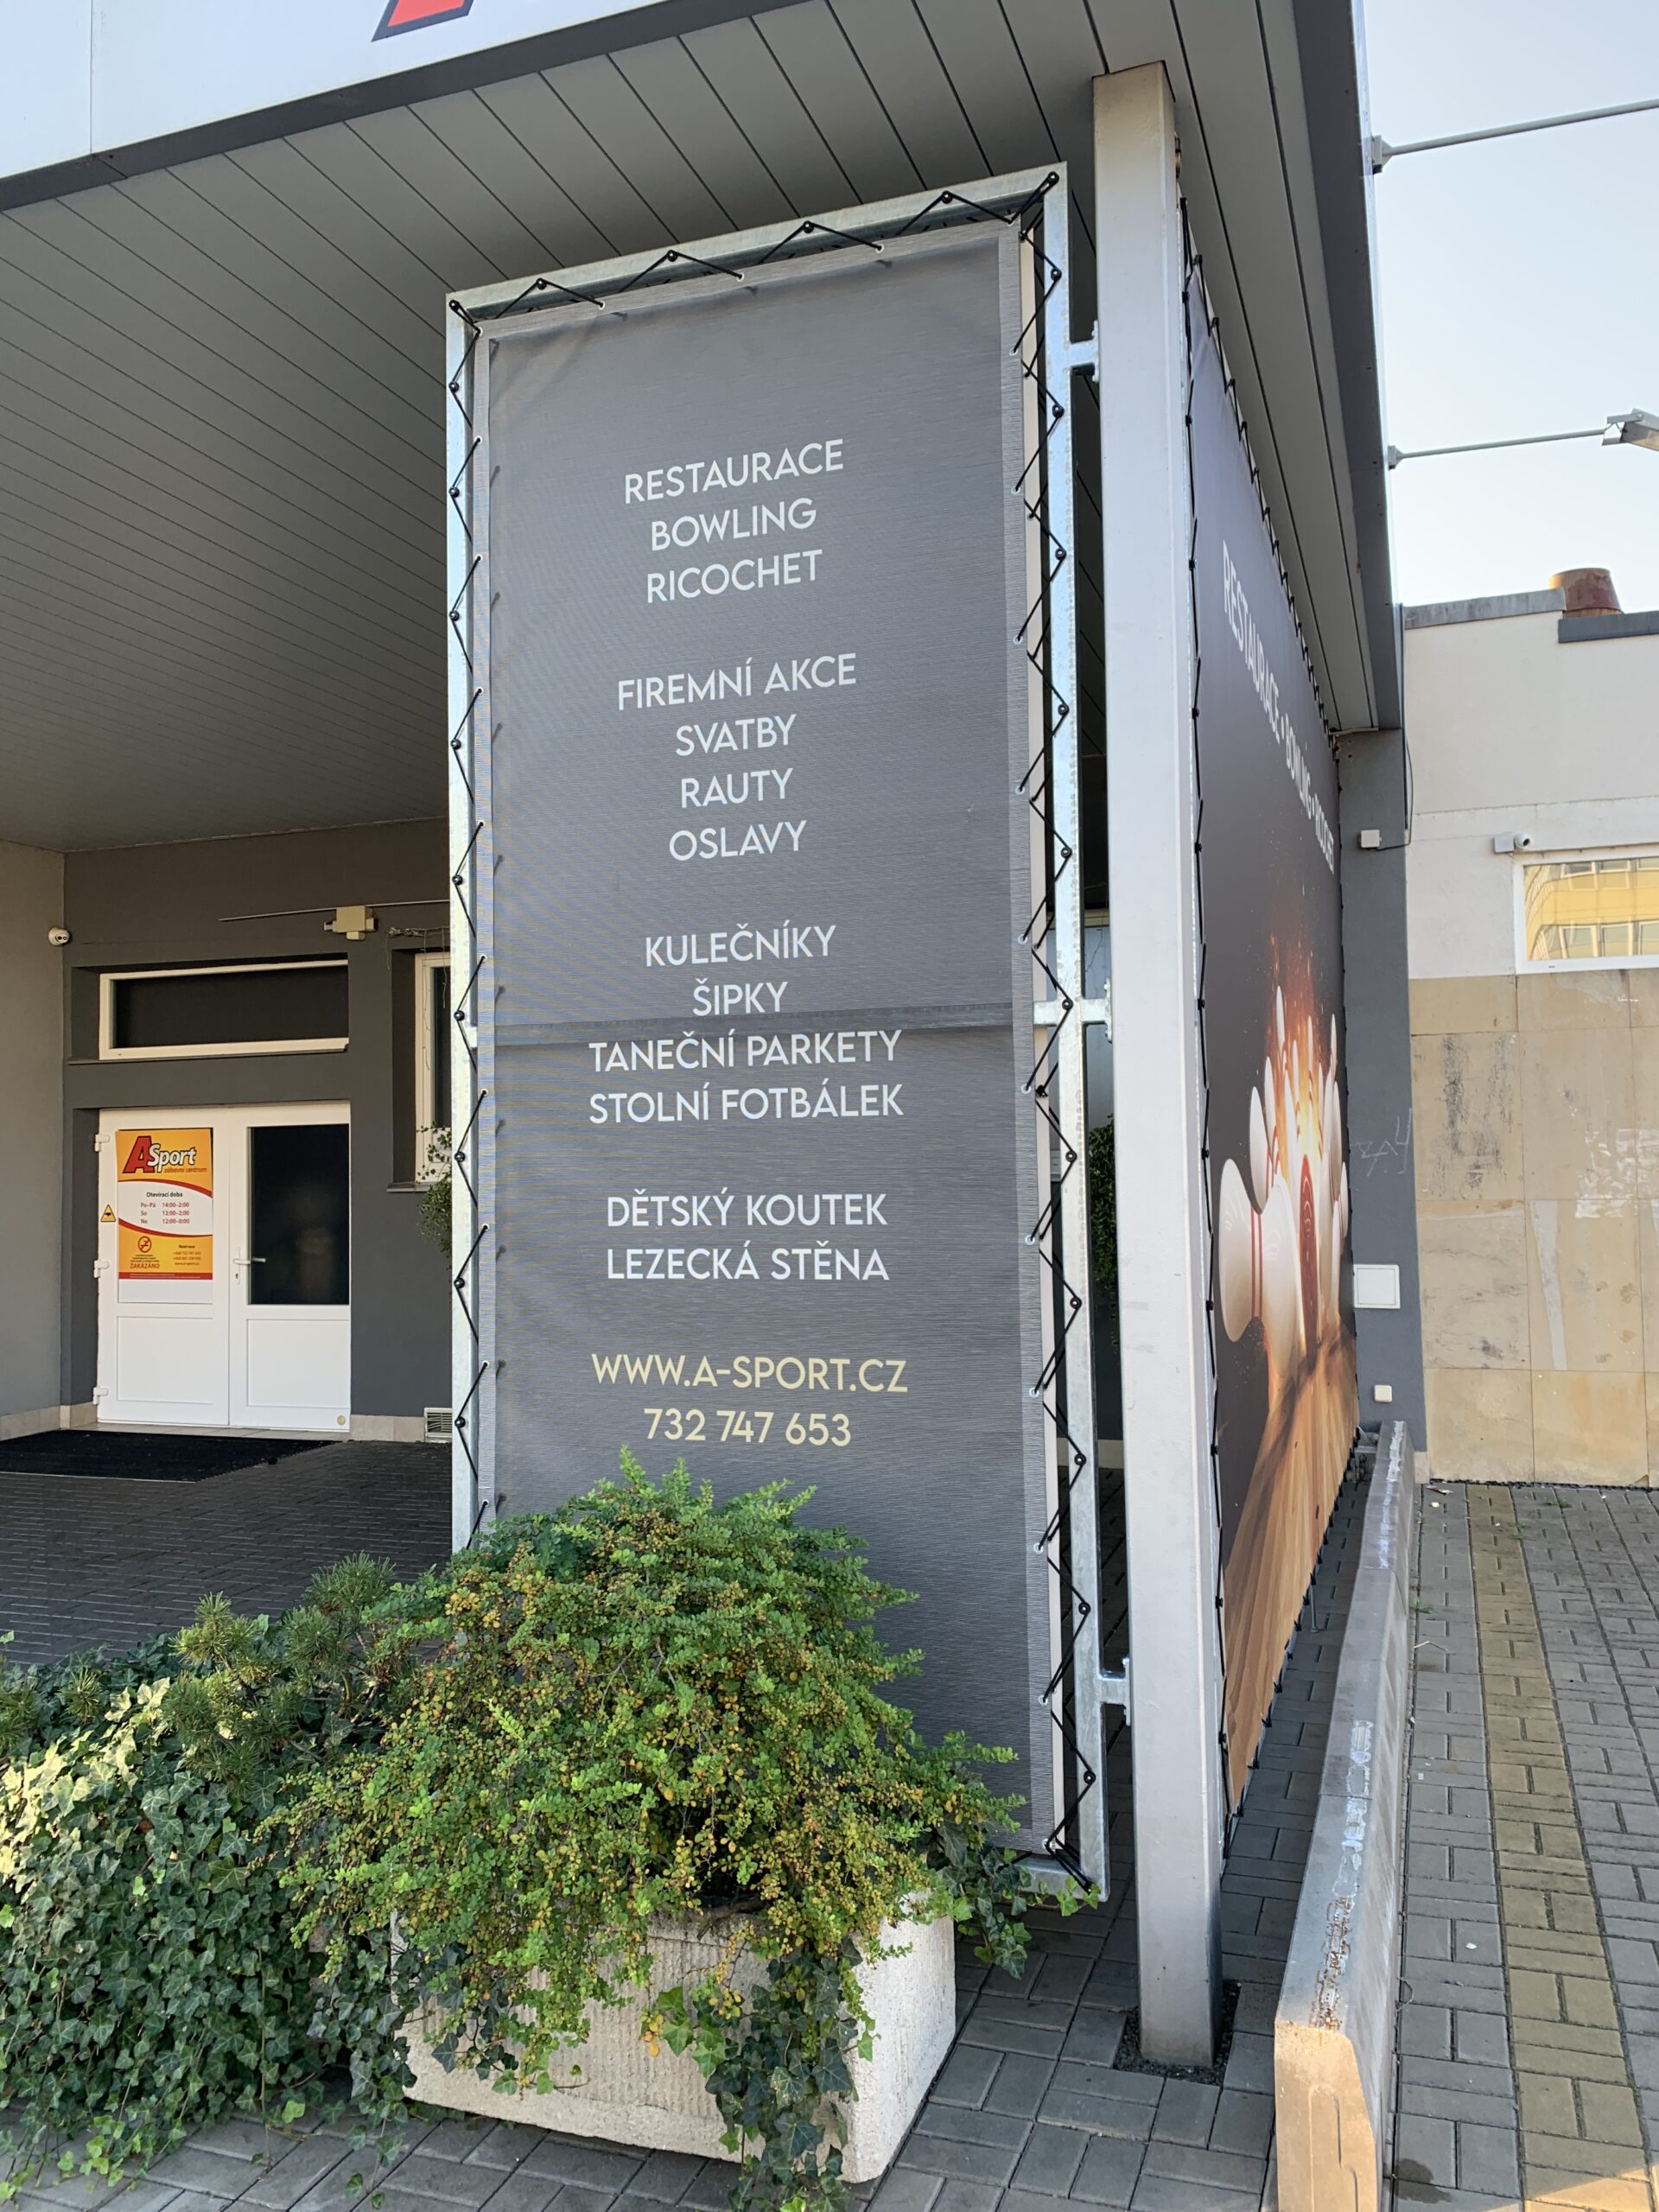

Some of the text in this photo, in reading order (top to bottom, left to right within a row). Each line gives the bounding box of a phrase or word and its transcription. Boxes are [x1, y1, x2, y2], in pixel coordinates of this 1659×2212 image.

[625, 438, 844, 505] RESTAURACE
[652, 497, 817, 551] BOWLING
[647, 549, 823, 604] RICOCHET
[618, 652, 856, 711] FIREMNÍ AKCE
[1222, 538, 1334, 875] RESTAURACE BOWLING RICOCHET
[675, 713, 797, 756] SVATBY
[681, 767, 794, 809] RAUTY
[669, 819, 807, 861] OSLAVY
[645, 919, 837, 967] KULEČNÍKY
[692, 977, 788, 1017] ŠIPKY
[588, 1028, 902, 1072] TANEČNÍ PARKETY
[589, 1077, 905, 1124] STOLNÍ FOTBÁLEK
[607, 1186, 888, 1227] DĚTSKÝ KOUTEK
[607, 1239, 890, 1281] LEZECKÁ STĚNA
[591, 1353, 908, 1393] WWW.A-SPORT.CZ
[644, 1408, 851, 1446] 732 747 653
